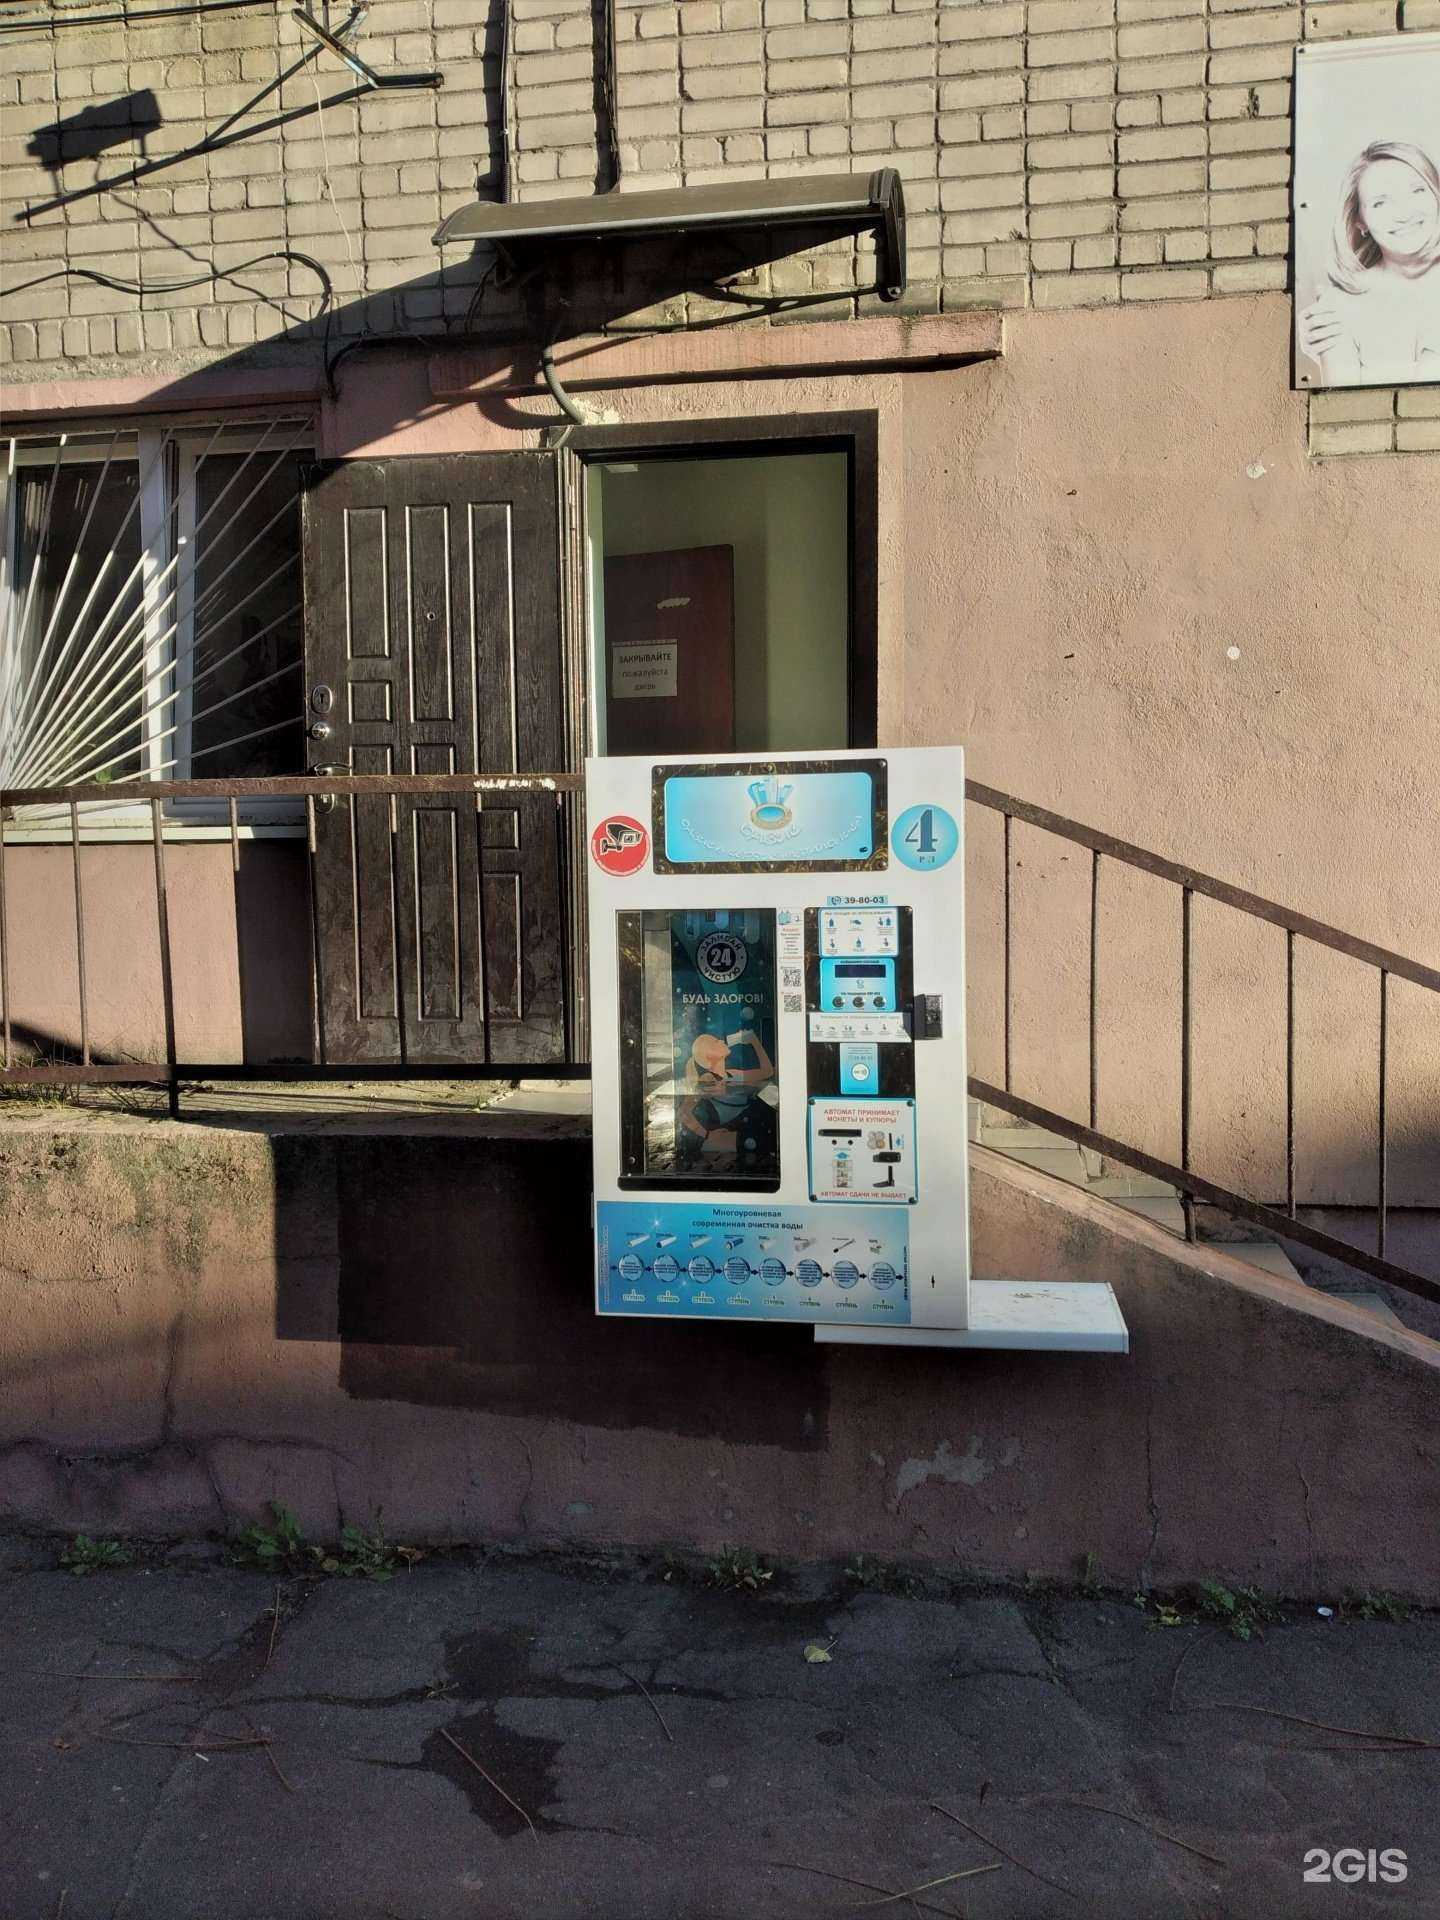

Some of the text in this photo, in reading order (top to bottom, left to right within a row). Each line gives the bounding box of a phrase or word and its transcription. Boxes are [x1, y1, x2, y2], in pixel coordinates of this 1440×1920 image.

[619, 649, 673, 664] ЗАКРЫВАЙТЕ
[622, 667, 669, 679] пожалуйста
[904, 809, 938, 853] 4
[845, 896, 884, 904] 39-80-03
[710, 947, 732, 967] 24
[704, 966, 741, 981] ЧИСТУЮ
[682, 993, 764, 1005] БУДЬ ЗДОРОВ!
[712, 1209, 782, 1219] Многоуровневая
[692, 1221, 746, 1229] современная
[781, 1223, 803, 1231] воды
